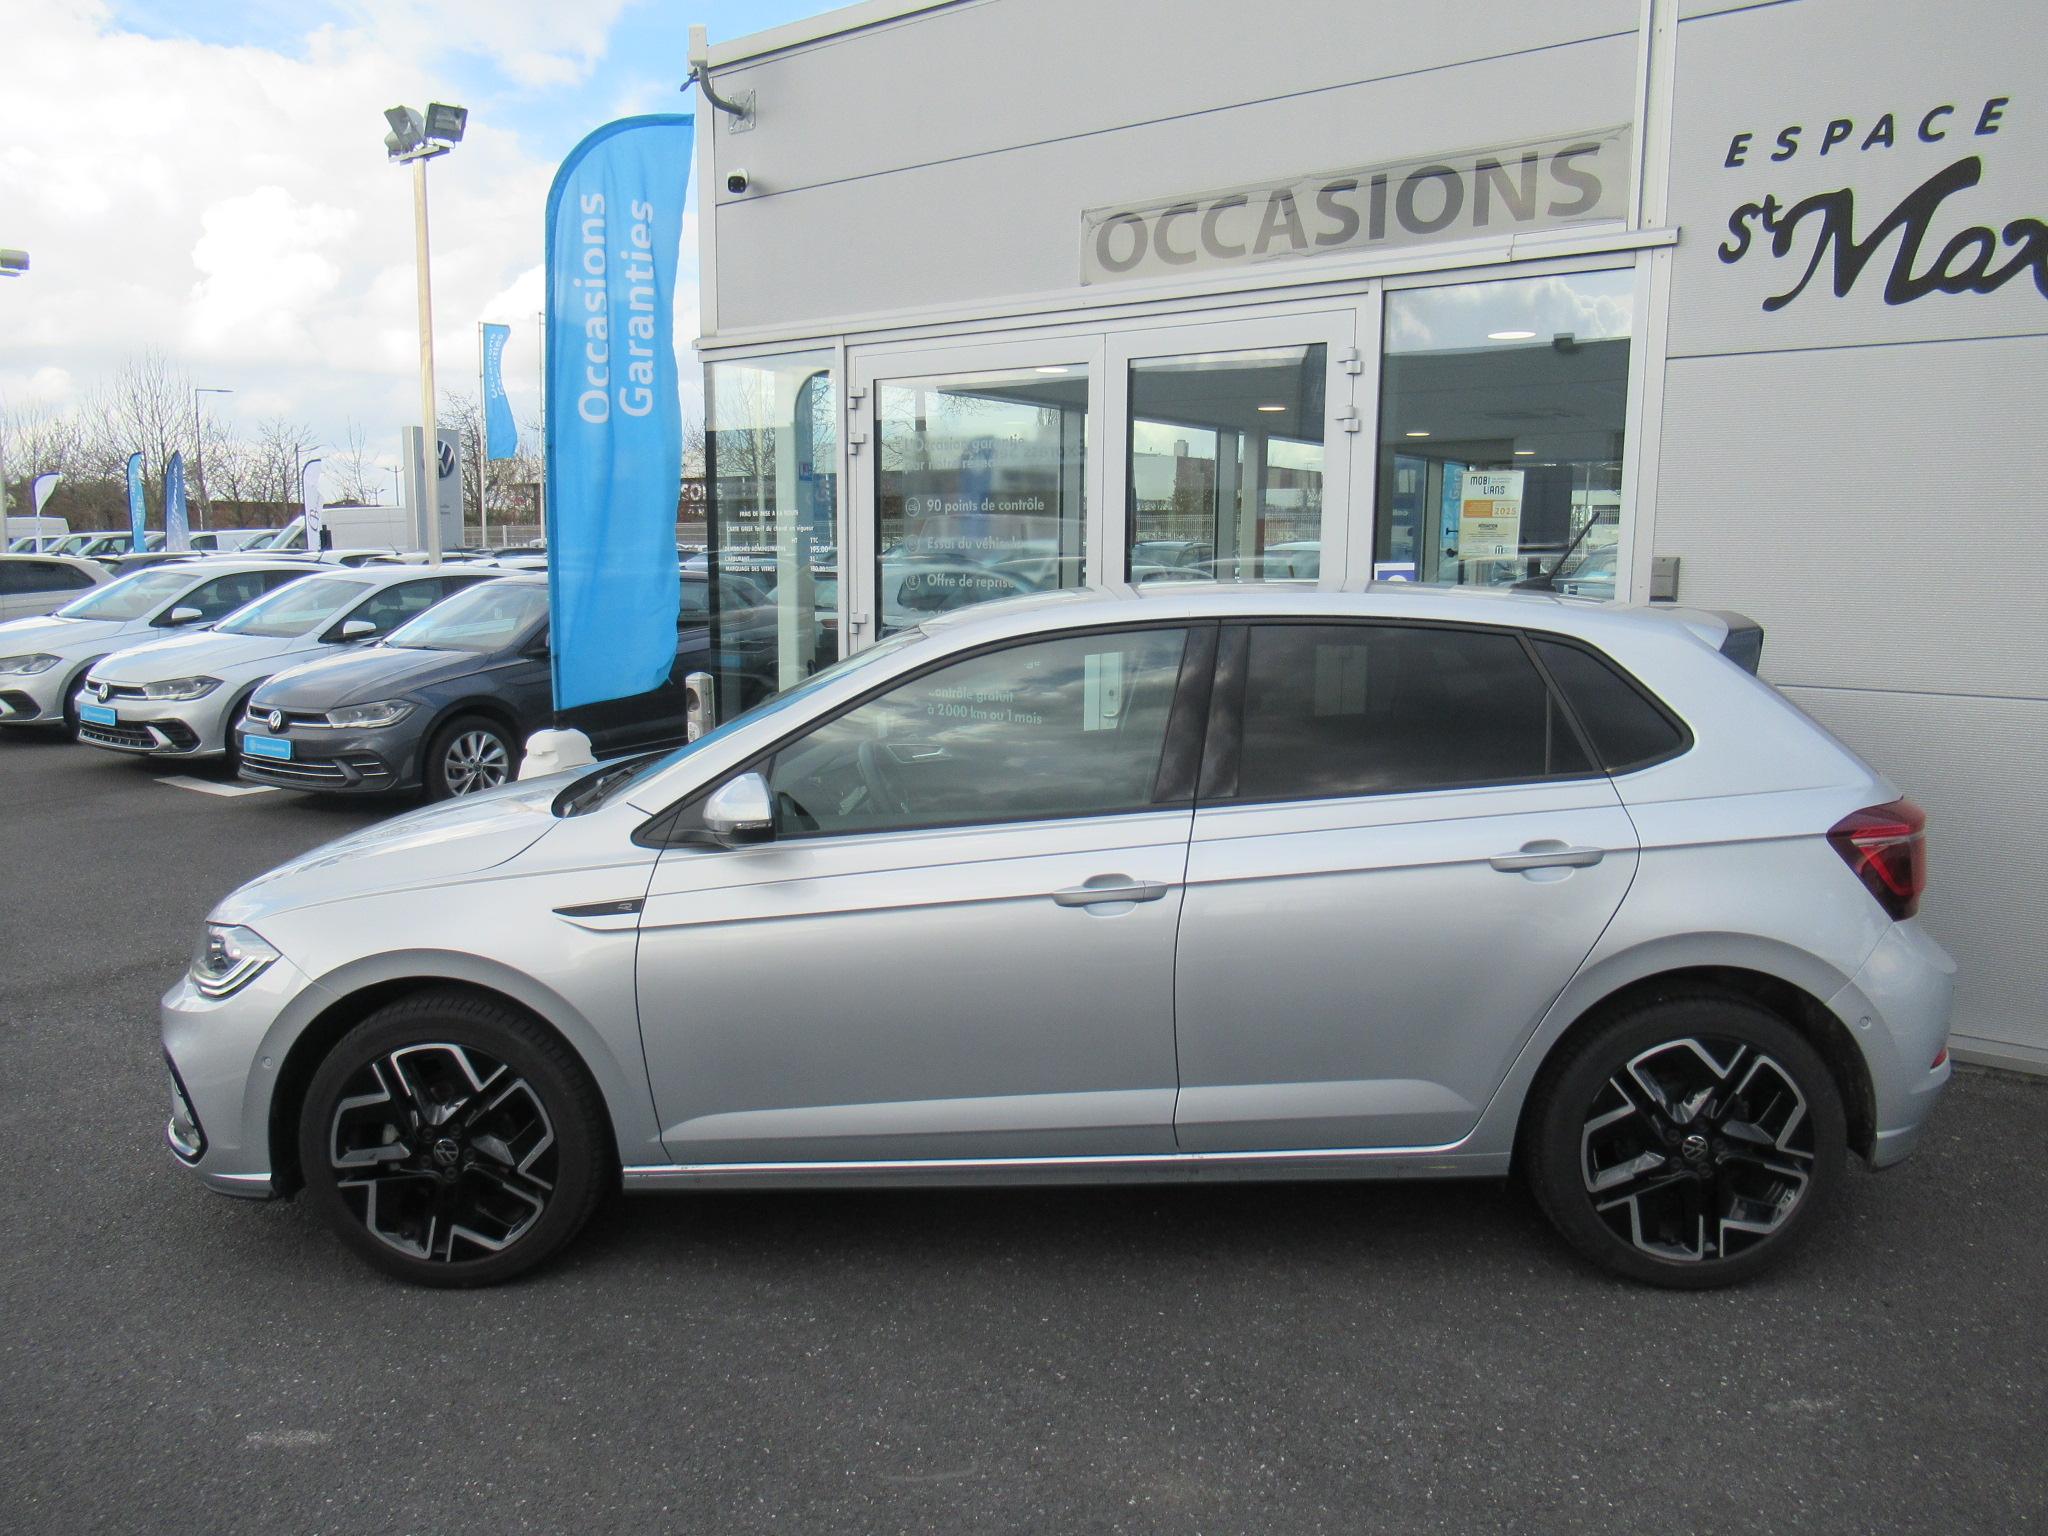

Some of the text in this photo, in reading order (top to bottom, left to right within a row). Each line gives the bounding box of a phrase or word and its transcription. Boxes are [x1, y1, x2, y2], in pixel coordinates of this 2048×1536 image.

[1724, 97, 2009, 168] ESPACE
[1096, 141, 1604, 273] OCCASIONS
[1718, 194, 1783, 264] St
[573, 192, 610, 424] Occasions
[619, 200, 655, 417] Garanties
[927, 496, 1045, 515] 90 points de contrôle
[927, 535, 955, 549] Essai
[958, 535, 972, 549] du
[927, 573, 1015, 591] Offre de reprise
[971, 706, 987, 720] km
[989, 711, 1003, 721] ou
[1014, 711, 1043, 725] mois
